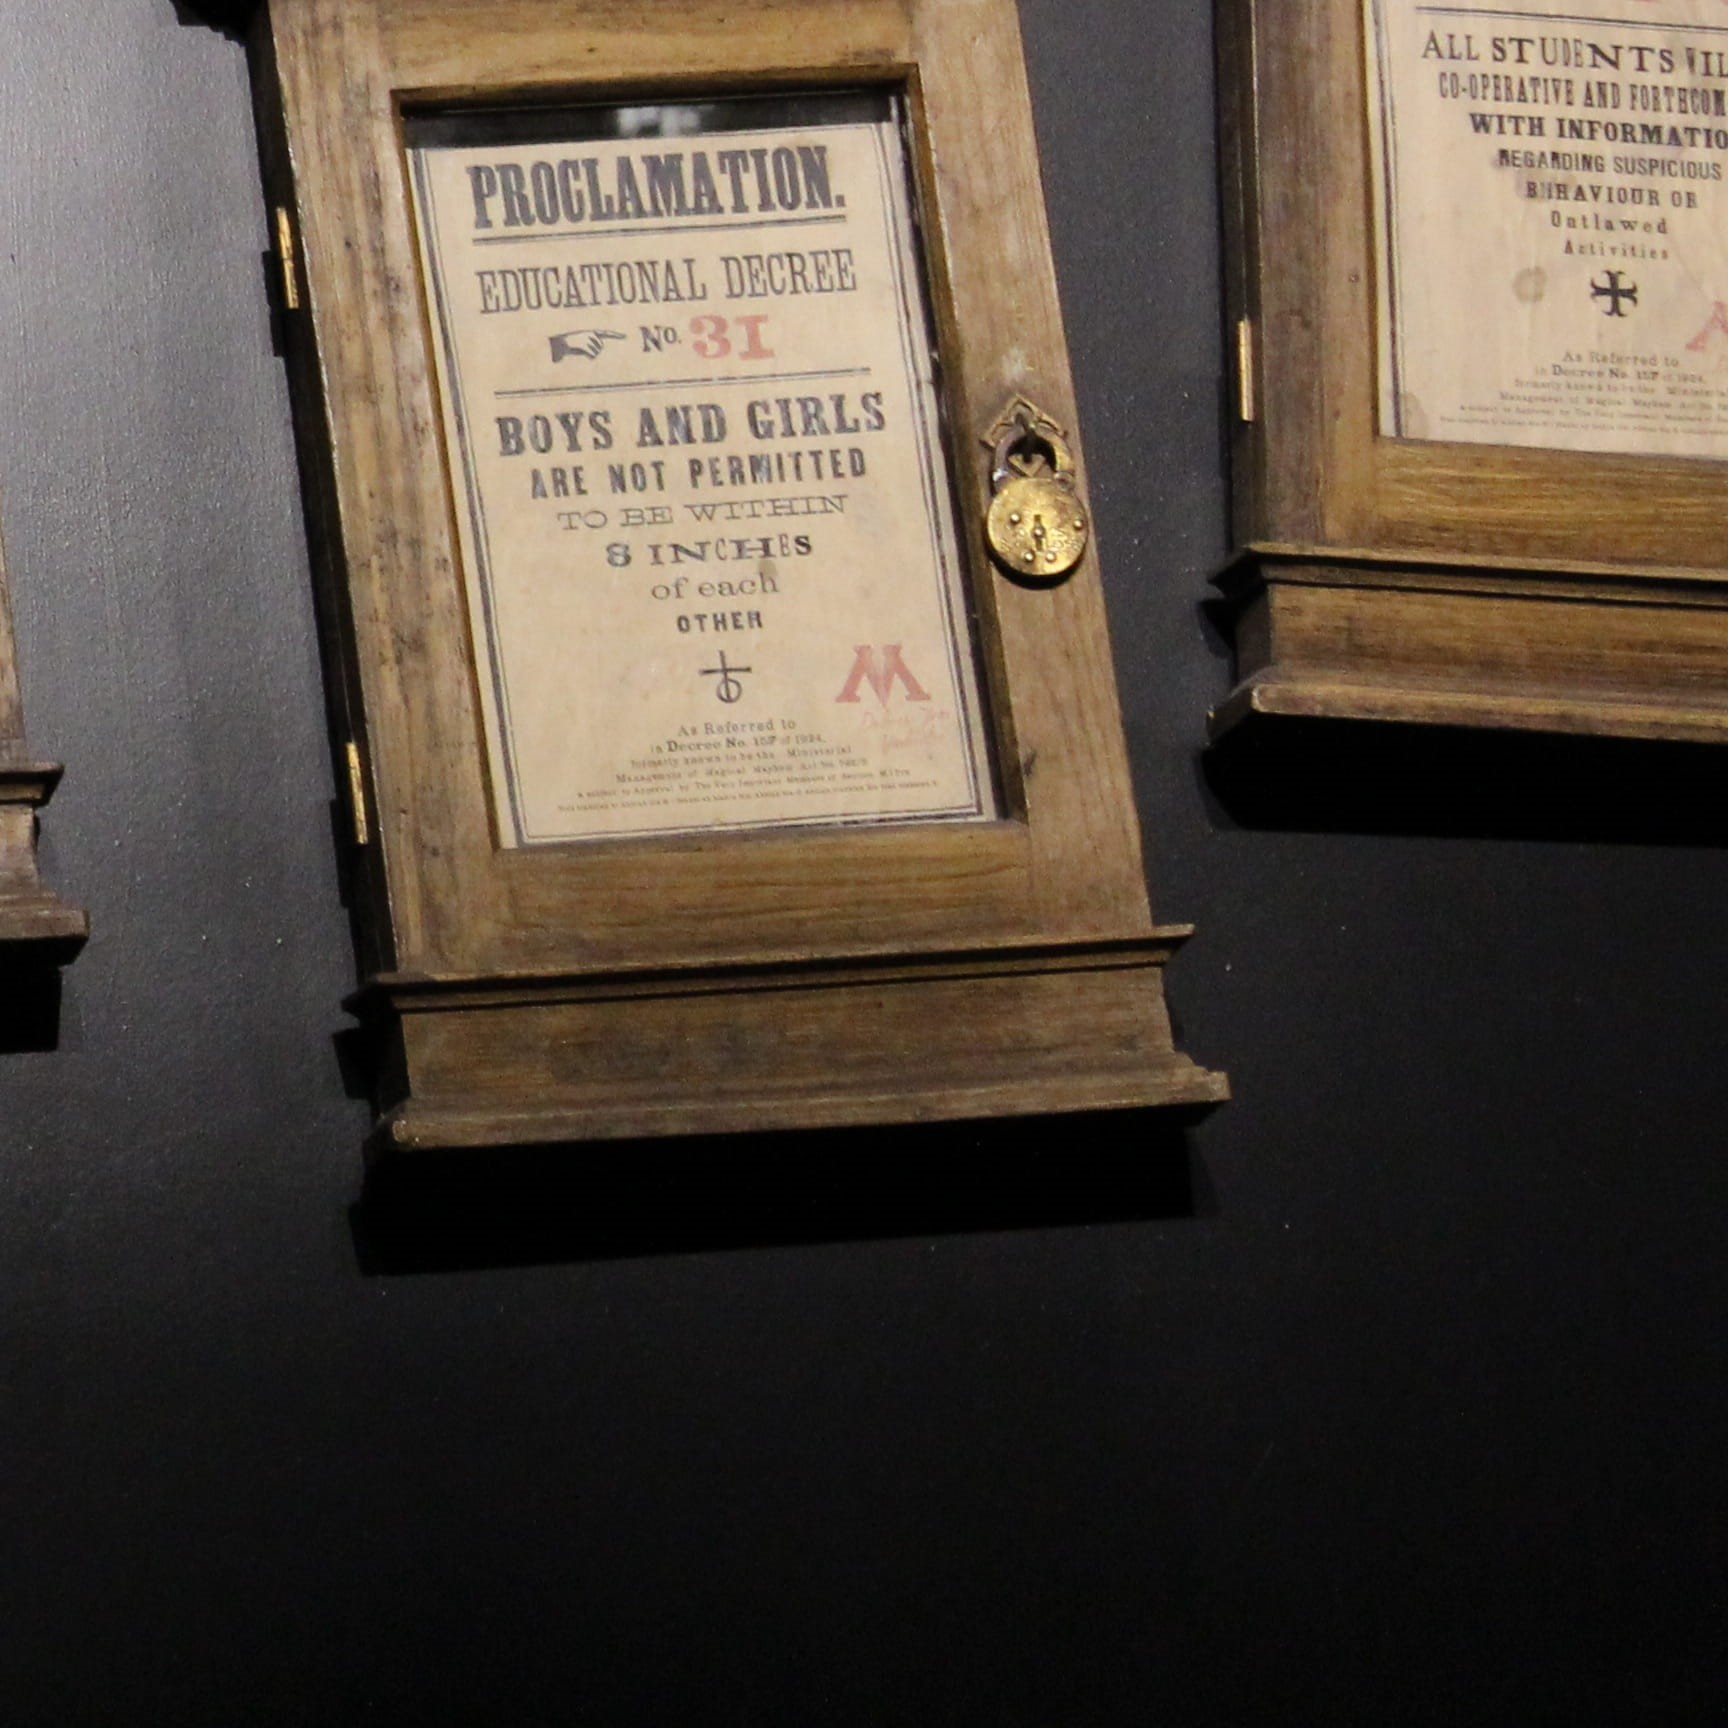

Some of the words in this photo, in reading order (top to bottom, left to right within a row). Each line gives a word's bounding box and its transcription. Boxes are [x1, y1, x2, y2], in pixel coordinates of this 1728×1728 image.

[1422, 30, 1479, 61] ALL
[1491, 36, 1674, 74] STUDENTS
[1439, 71, 1574, 107] CO-OPERATIVE
[1584, 79, 1621, 109] AND
[1469, 112, 1544, 138] WITH
[1498, 148, 1605, 172] REGARDING
[1613, 156, 1722, 181] SUSPICIOUS
[466, 144, 846, 230] PROCLAMATION.
[1671, 191, 1698, 209] OR
[1551, 210, 1668, 235] Outlawed
[1564, 240, 1669, 260] Activities
[475, 259, 707, 315] EDUCATIONAL
[720, 248, 857, 299] DECREE
[496, 410, 614, 457] BOYS
[636, 402, 727, 449] AND
[746, 392, 886, 441] GIRLS
[530, 466, 588, 500] ARE
[608, 461, 666, 494] NOT
[688, 448, 868, 490] PERMITTED
[557, 510, 608, 531] TO
[619, 506, 674, 527] BE
[684, 493, 849, 524] WITHIN
[605, 543, 632, 566] 8
[649, 534, 814, 566] INCHES
[651, 576, 689, 601] of
[697, 575, 781, 598] each
[676, 610, 765, 634] OTHER
